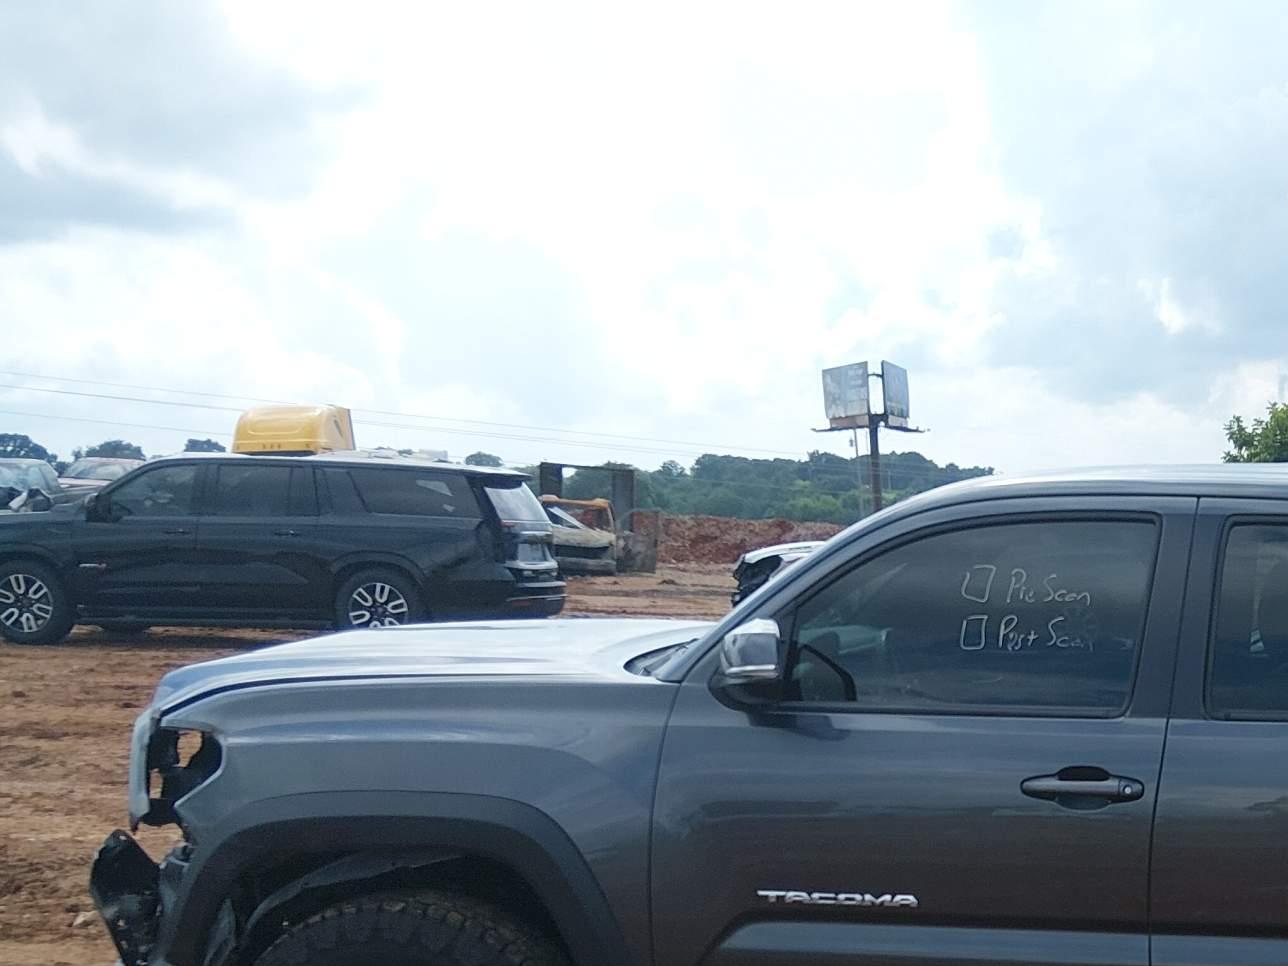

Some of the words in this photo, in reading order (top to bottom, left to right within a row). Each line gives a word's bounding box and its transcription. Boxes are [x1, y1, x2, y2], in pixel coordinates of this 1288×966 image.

[1006, 568, 1035, 603] Pre
[1043, 574, 1091, 606] Scan
[999, 614, 1039, 651] Post
[1047, 616, 1094, 651] Scan
[756, 889, 920, 908] TACOMA
